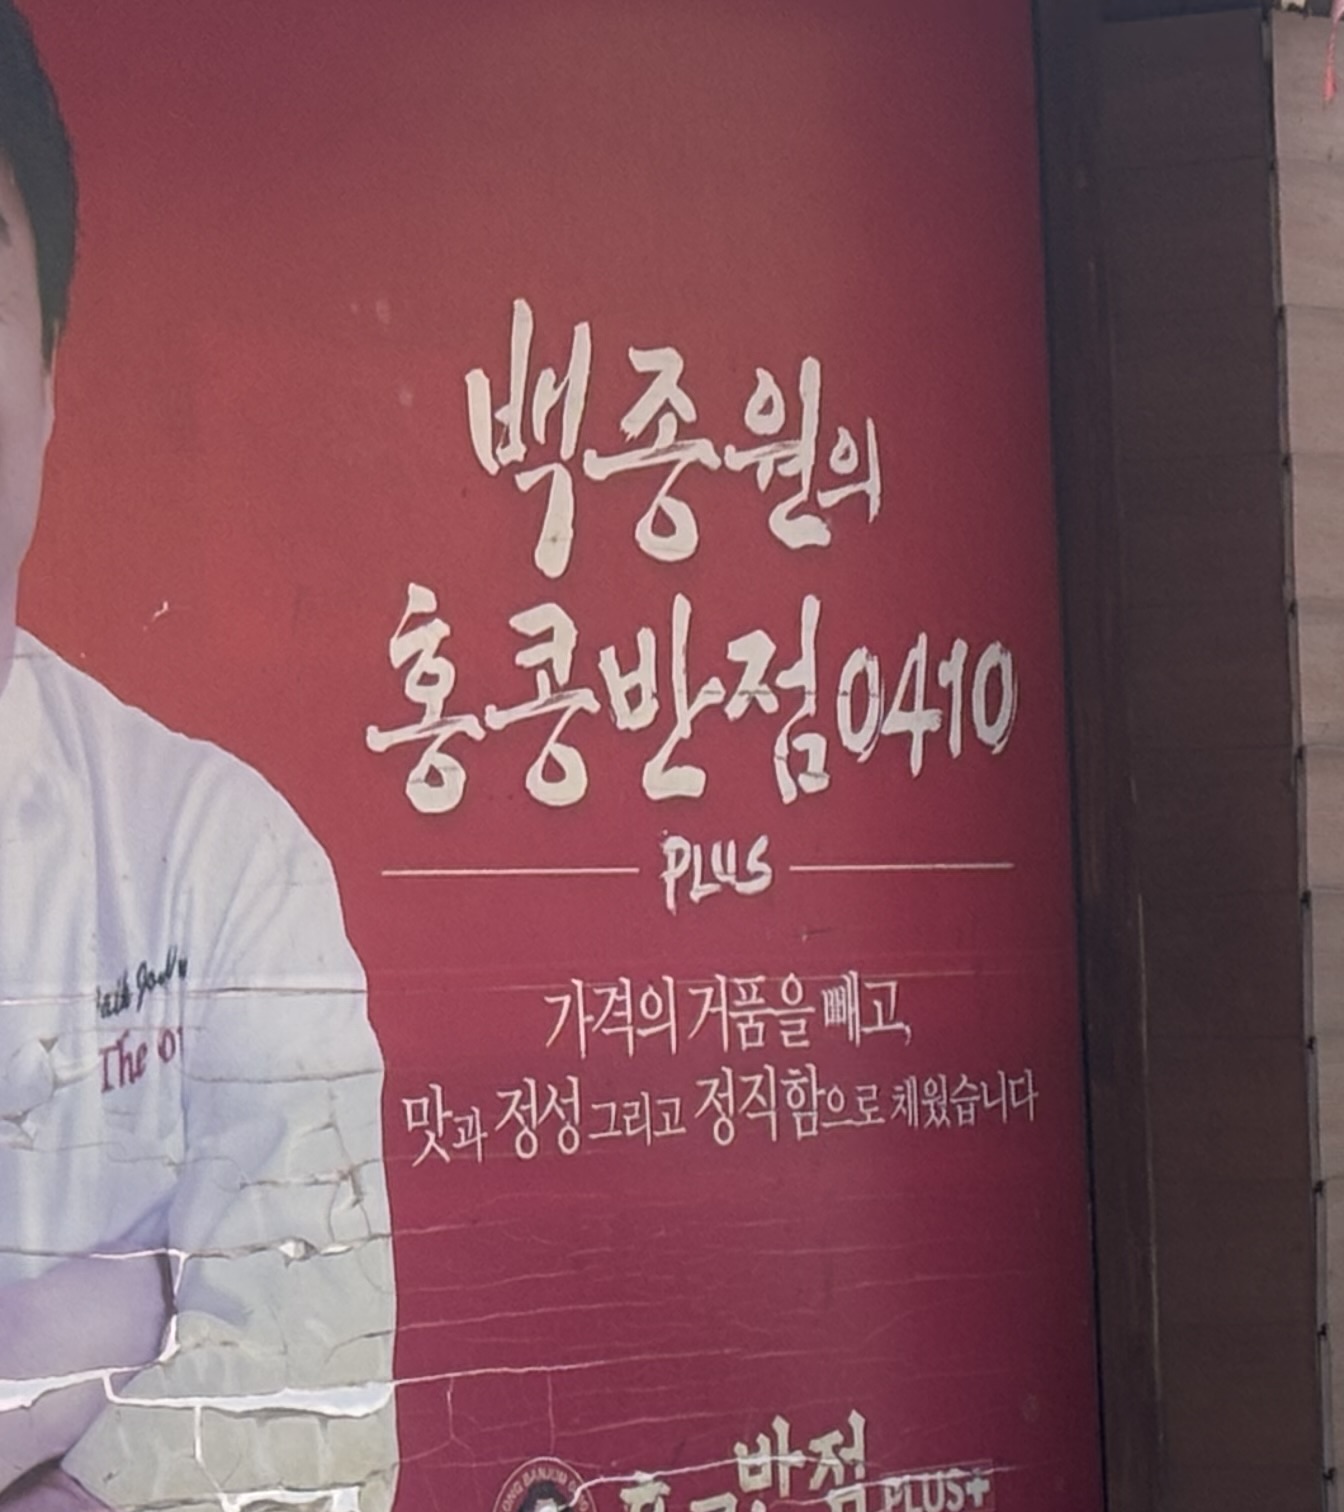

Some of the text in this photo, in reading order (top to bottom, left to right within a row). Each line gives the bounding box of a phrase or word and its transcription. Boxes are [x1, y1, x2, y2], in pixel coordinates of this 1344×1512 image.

[465, 297, 882, 577] 백종원의
[366, 581, 1018, 814] 홍콩반점0410
[659, 831, 773, 915] PLUS
[99, 1028, 147, 1093] The
[544, 969, 912, 1058] 가격의 거품을 빼고,
[401, 1063, 1039, 1168] 맛과 정성 그리고 정직함으로 채웠습니다
